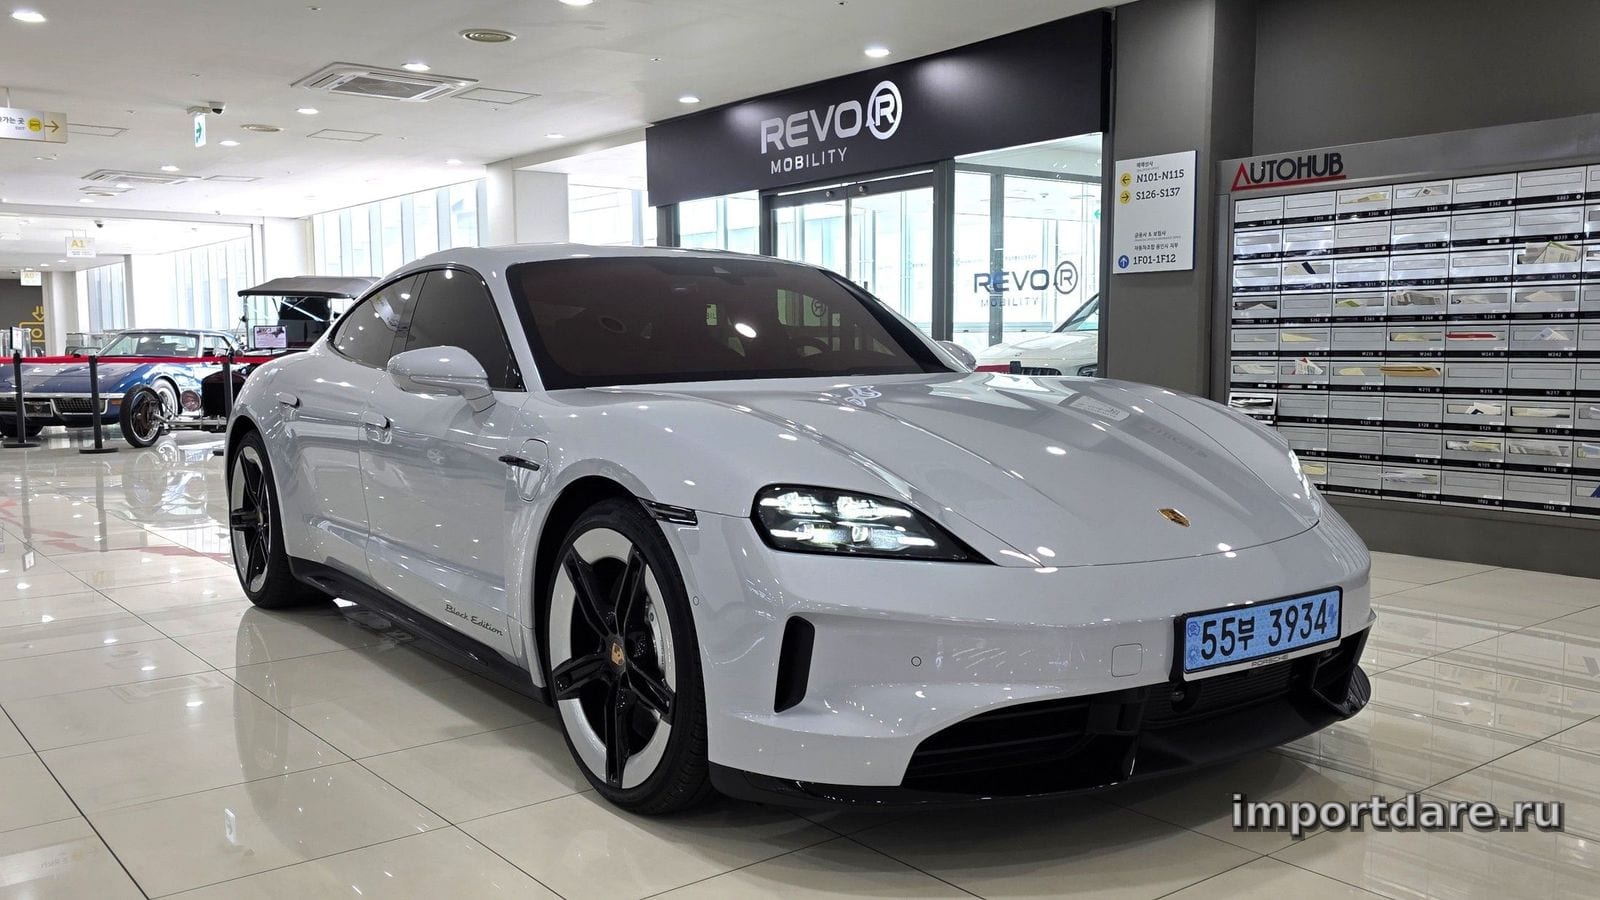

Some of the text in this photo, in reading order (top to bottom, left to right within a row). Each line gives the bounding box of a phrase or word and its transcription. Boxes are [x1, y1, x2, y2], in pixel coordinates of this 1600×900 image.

[760, 100, 862, 154] REVO
[771, 147, 847, 174] MOBILITY
[1231, 152, 1345, 192] AUTOHUB
[1136, 169, 1185, 183] N101-N115
[1136, 187, 1180, 200] S126-S137
[1133, 254, 1177, 265] 1F01-1F12
[974, 270, 1050, 293] REVO
[444, 604, 503, 636] Black Edition
[1200, 598, 1328, 660] 55부 3934
